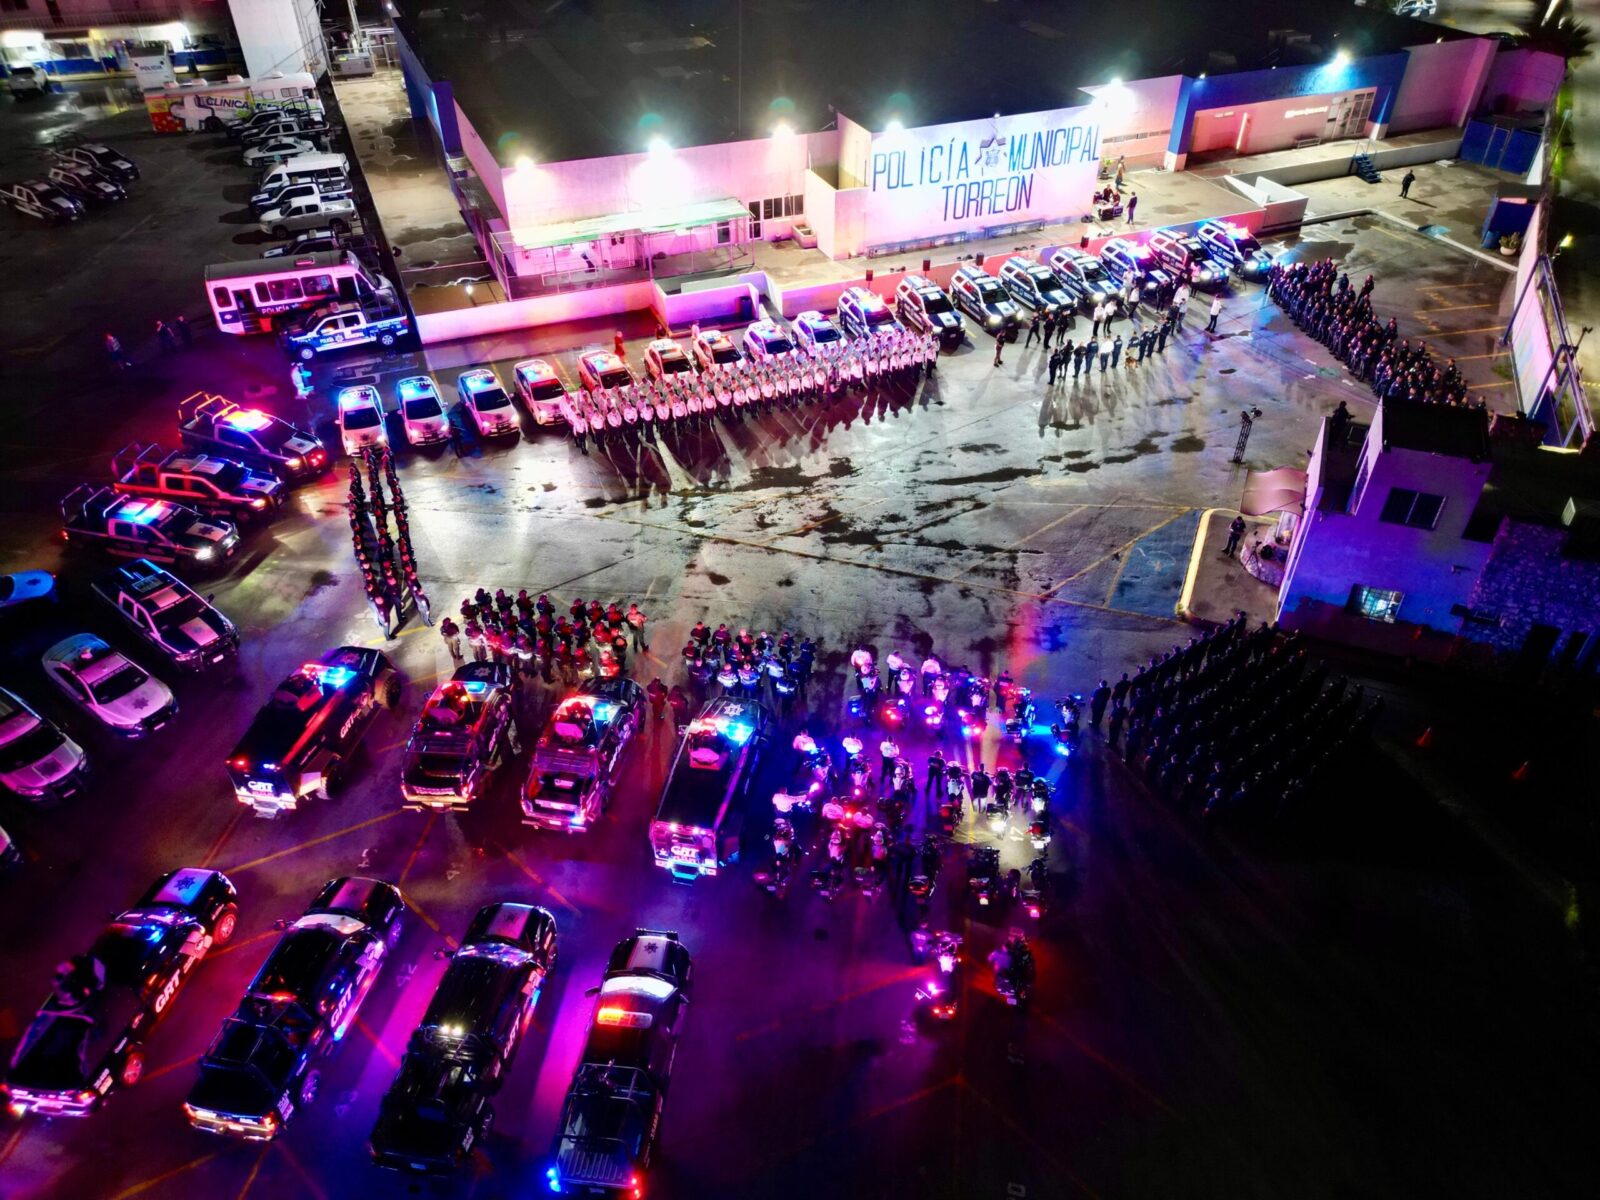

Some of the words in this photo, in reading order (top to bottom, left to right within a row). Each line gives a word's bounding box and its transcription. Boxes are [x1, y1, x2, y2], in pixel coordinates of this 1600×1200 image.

[206, 96, 250, 110] CLÍNICA
[872, 137, 969, 192] POLICÍA
[1008, 123, 1099, 173] MUNICIPAL
[942, 171, 1034, 221] TORREÓN
